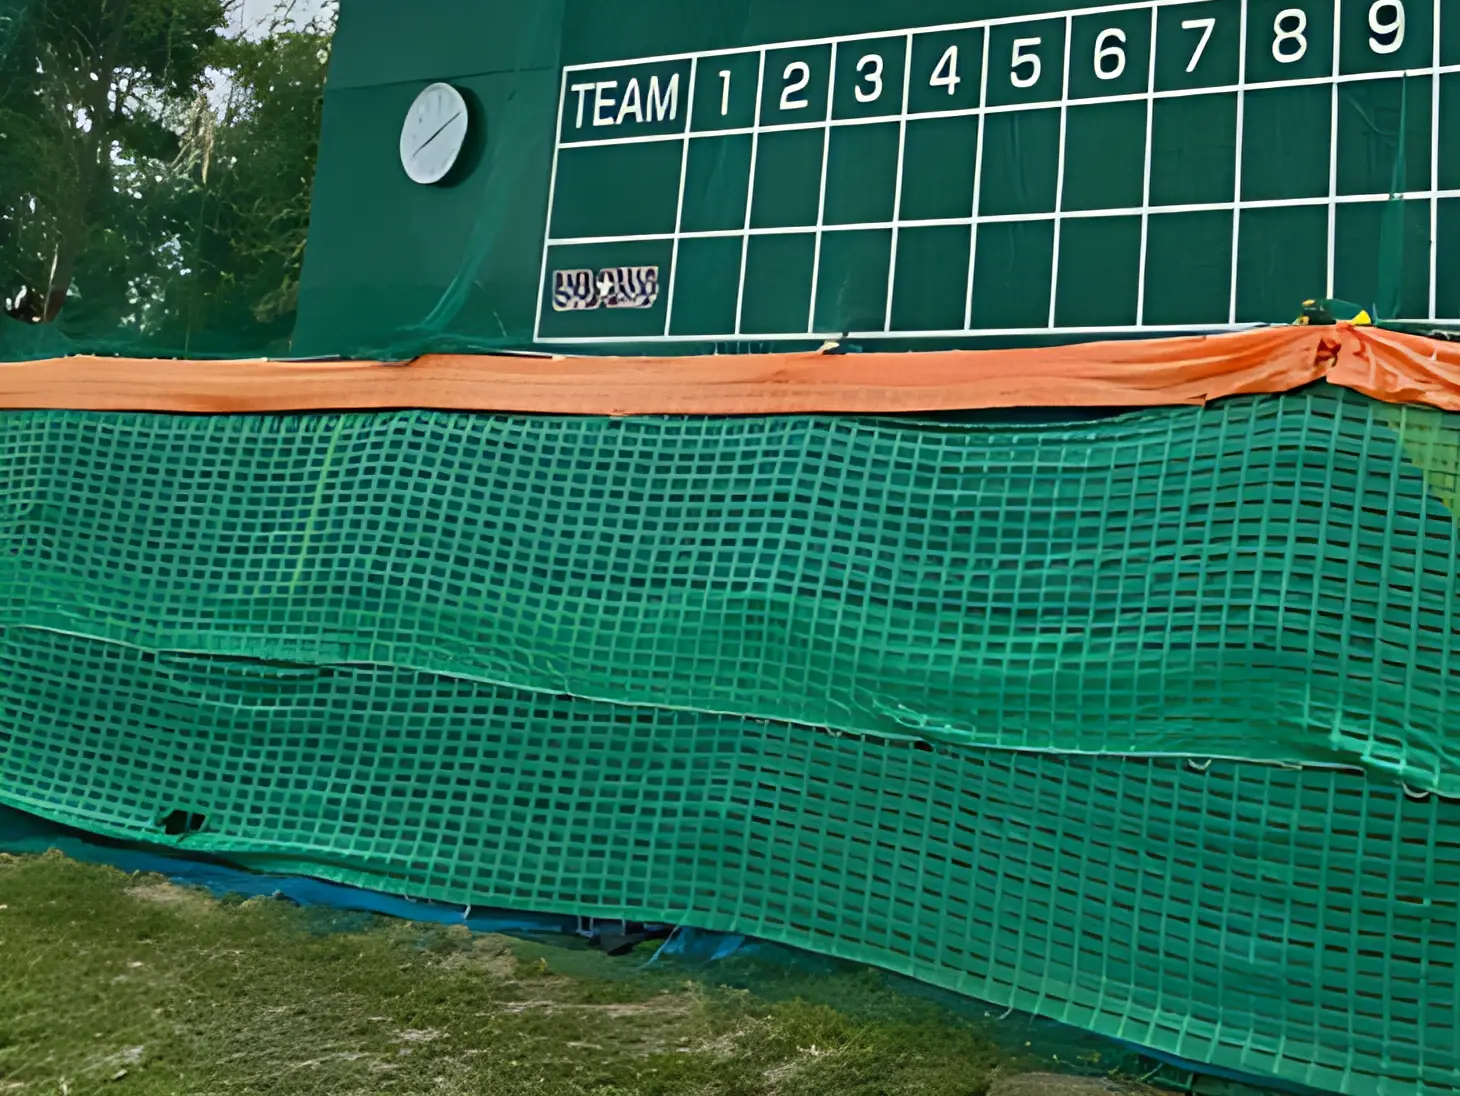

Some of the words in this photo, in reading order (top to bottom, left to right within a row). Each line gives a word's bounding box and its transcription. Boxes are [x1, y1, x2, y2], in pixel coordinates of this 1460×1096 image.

[571, 72, 679, 129] TEAM
[718, 70, 731, 115] 1
[779, 61, 811, 110] 2
[854, 54, 884, 102] 3
[929, 45, 961, 95] 4
[1010, 37, 1042, 88] 5
[1093, 28, 1127, 80] 6
[1181, 18, 1216, 72] 7
[1271, 8, 1308, 63] 8
